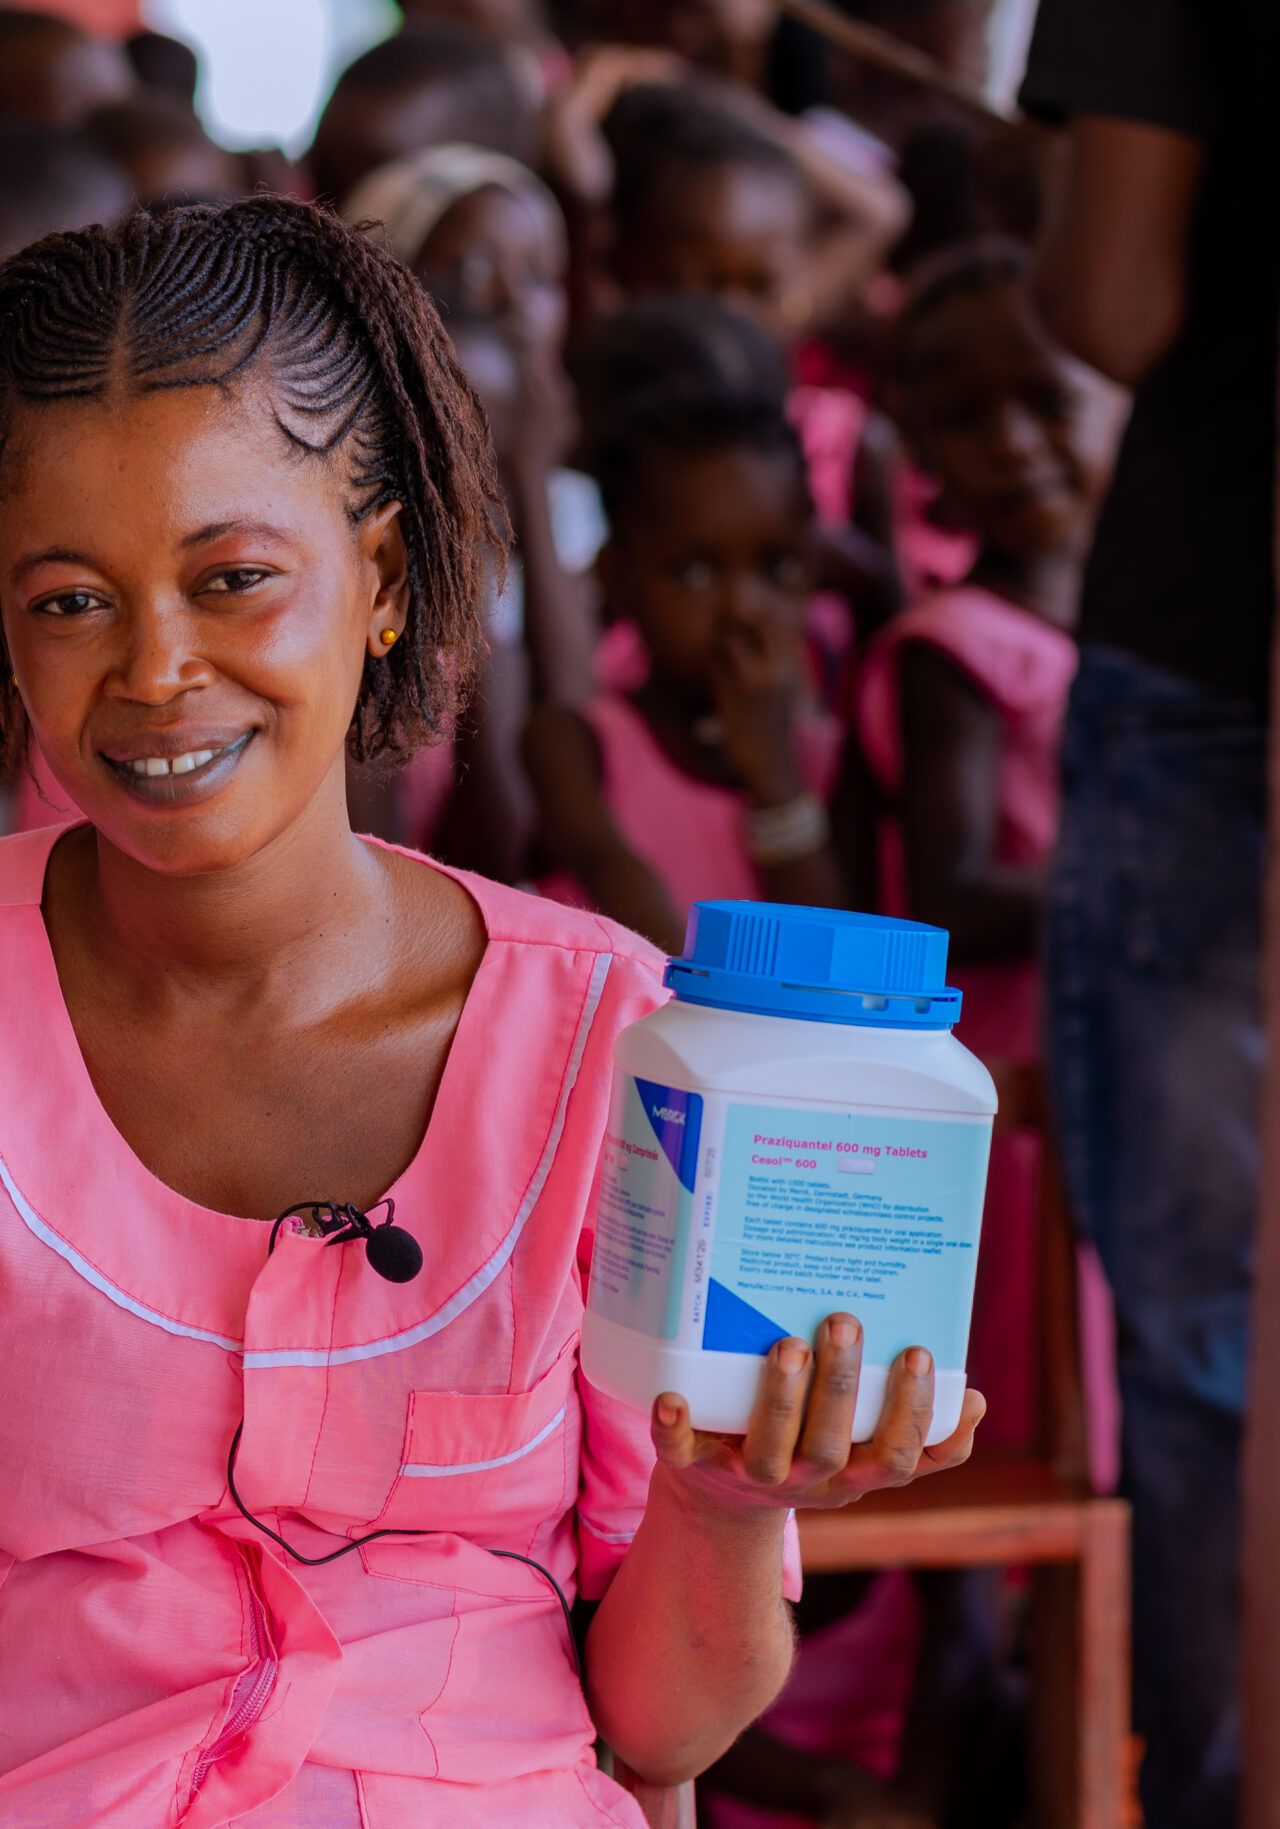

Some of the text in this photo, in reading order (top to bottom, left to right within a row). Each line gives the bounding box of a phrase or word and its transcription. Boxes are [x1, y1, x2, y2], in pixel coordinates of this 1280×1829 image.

[754, 1135, 928, 1158] Praziquantel 600 mg Tablets
[795, 1158, 817, 1169] 600
